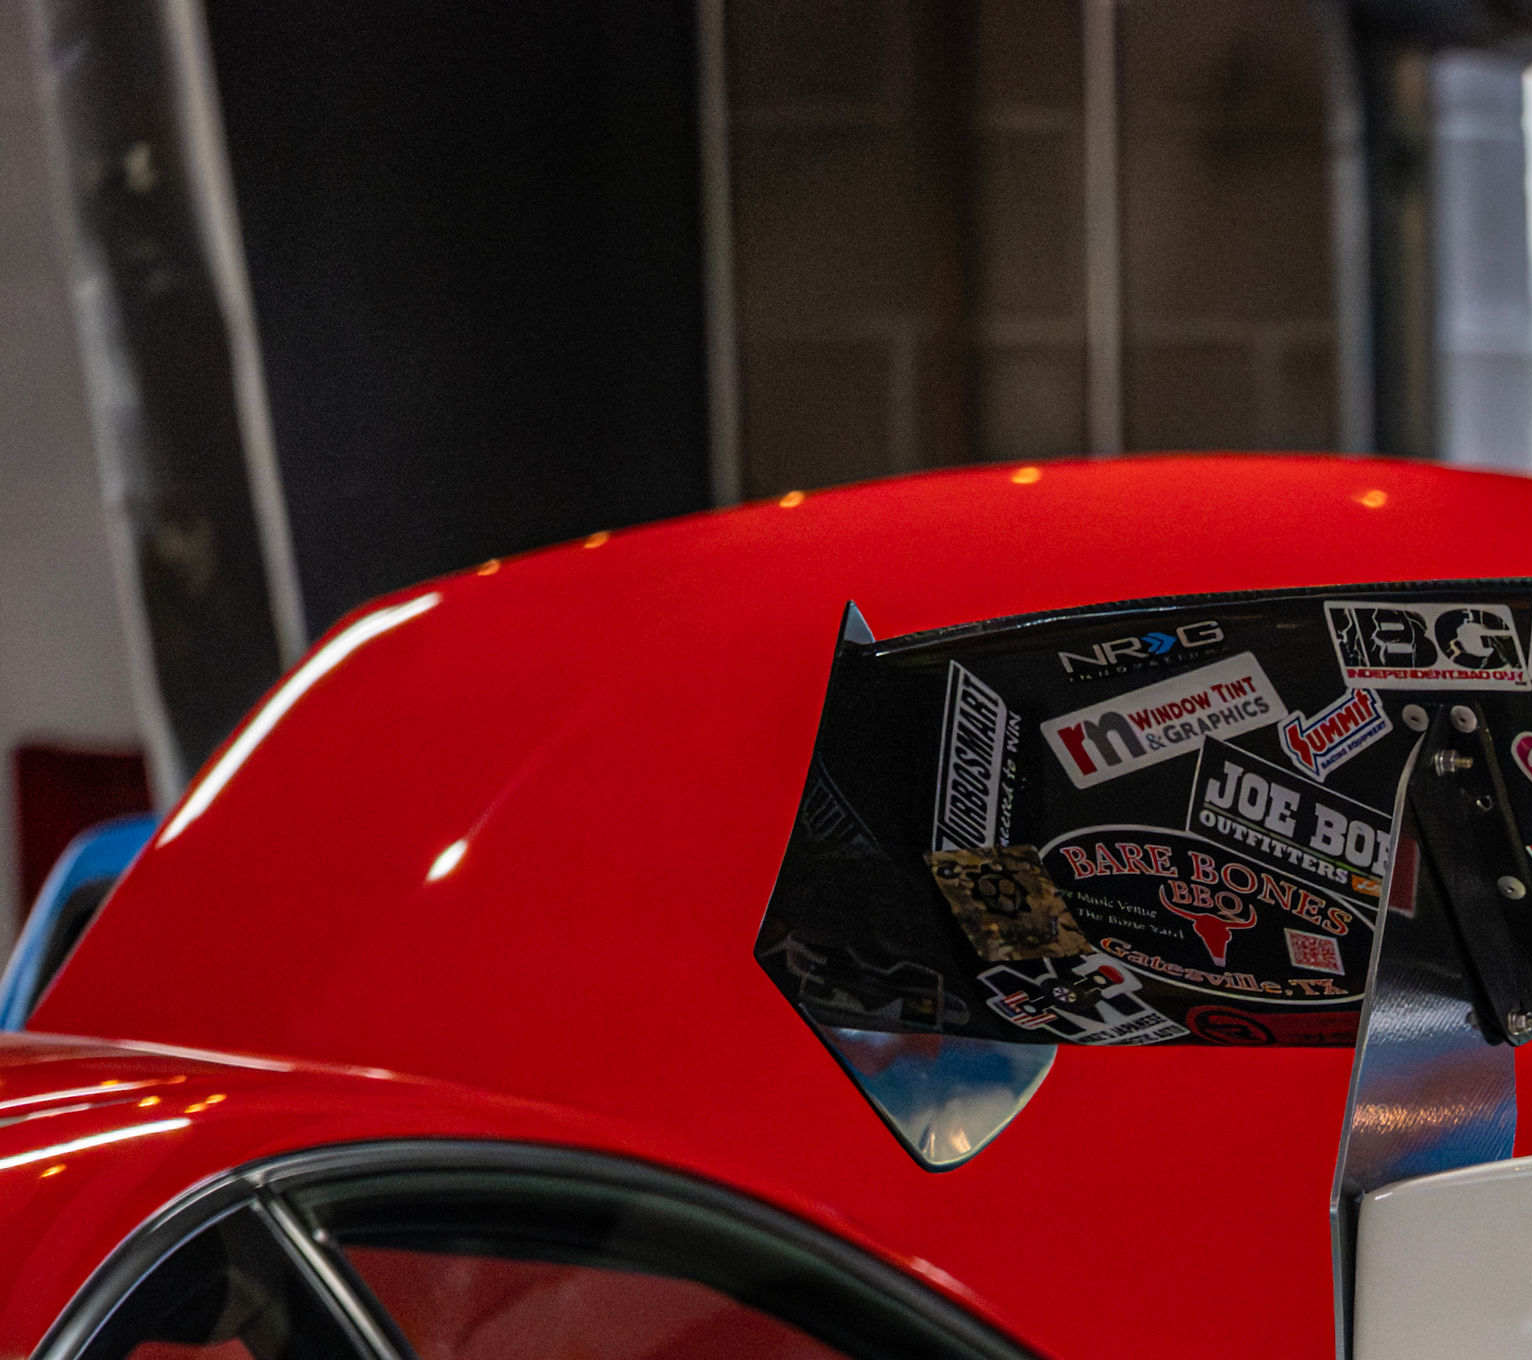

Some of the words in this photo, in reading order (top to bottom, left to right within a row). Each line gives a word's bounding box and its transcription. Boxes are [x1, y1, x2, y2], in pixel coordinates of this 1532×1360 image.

[1127, 691, 1212, 732] WINDOW
[1210, 676, 1257, 704] TINT
[1163, 696, 1271, 745] GRAPHICS
[1205, 760, 1300, 839] JOE
[1200, 809, 1349, 885] OUTFITTERS
[1061, 842, 1178, 880] BARE
[1188, 850, 1353, 936] BONES
[1168, 879, 1248, 923] BBQ
